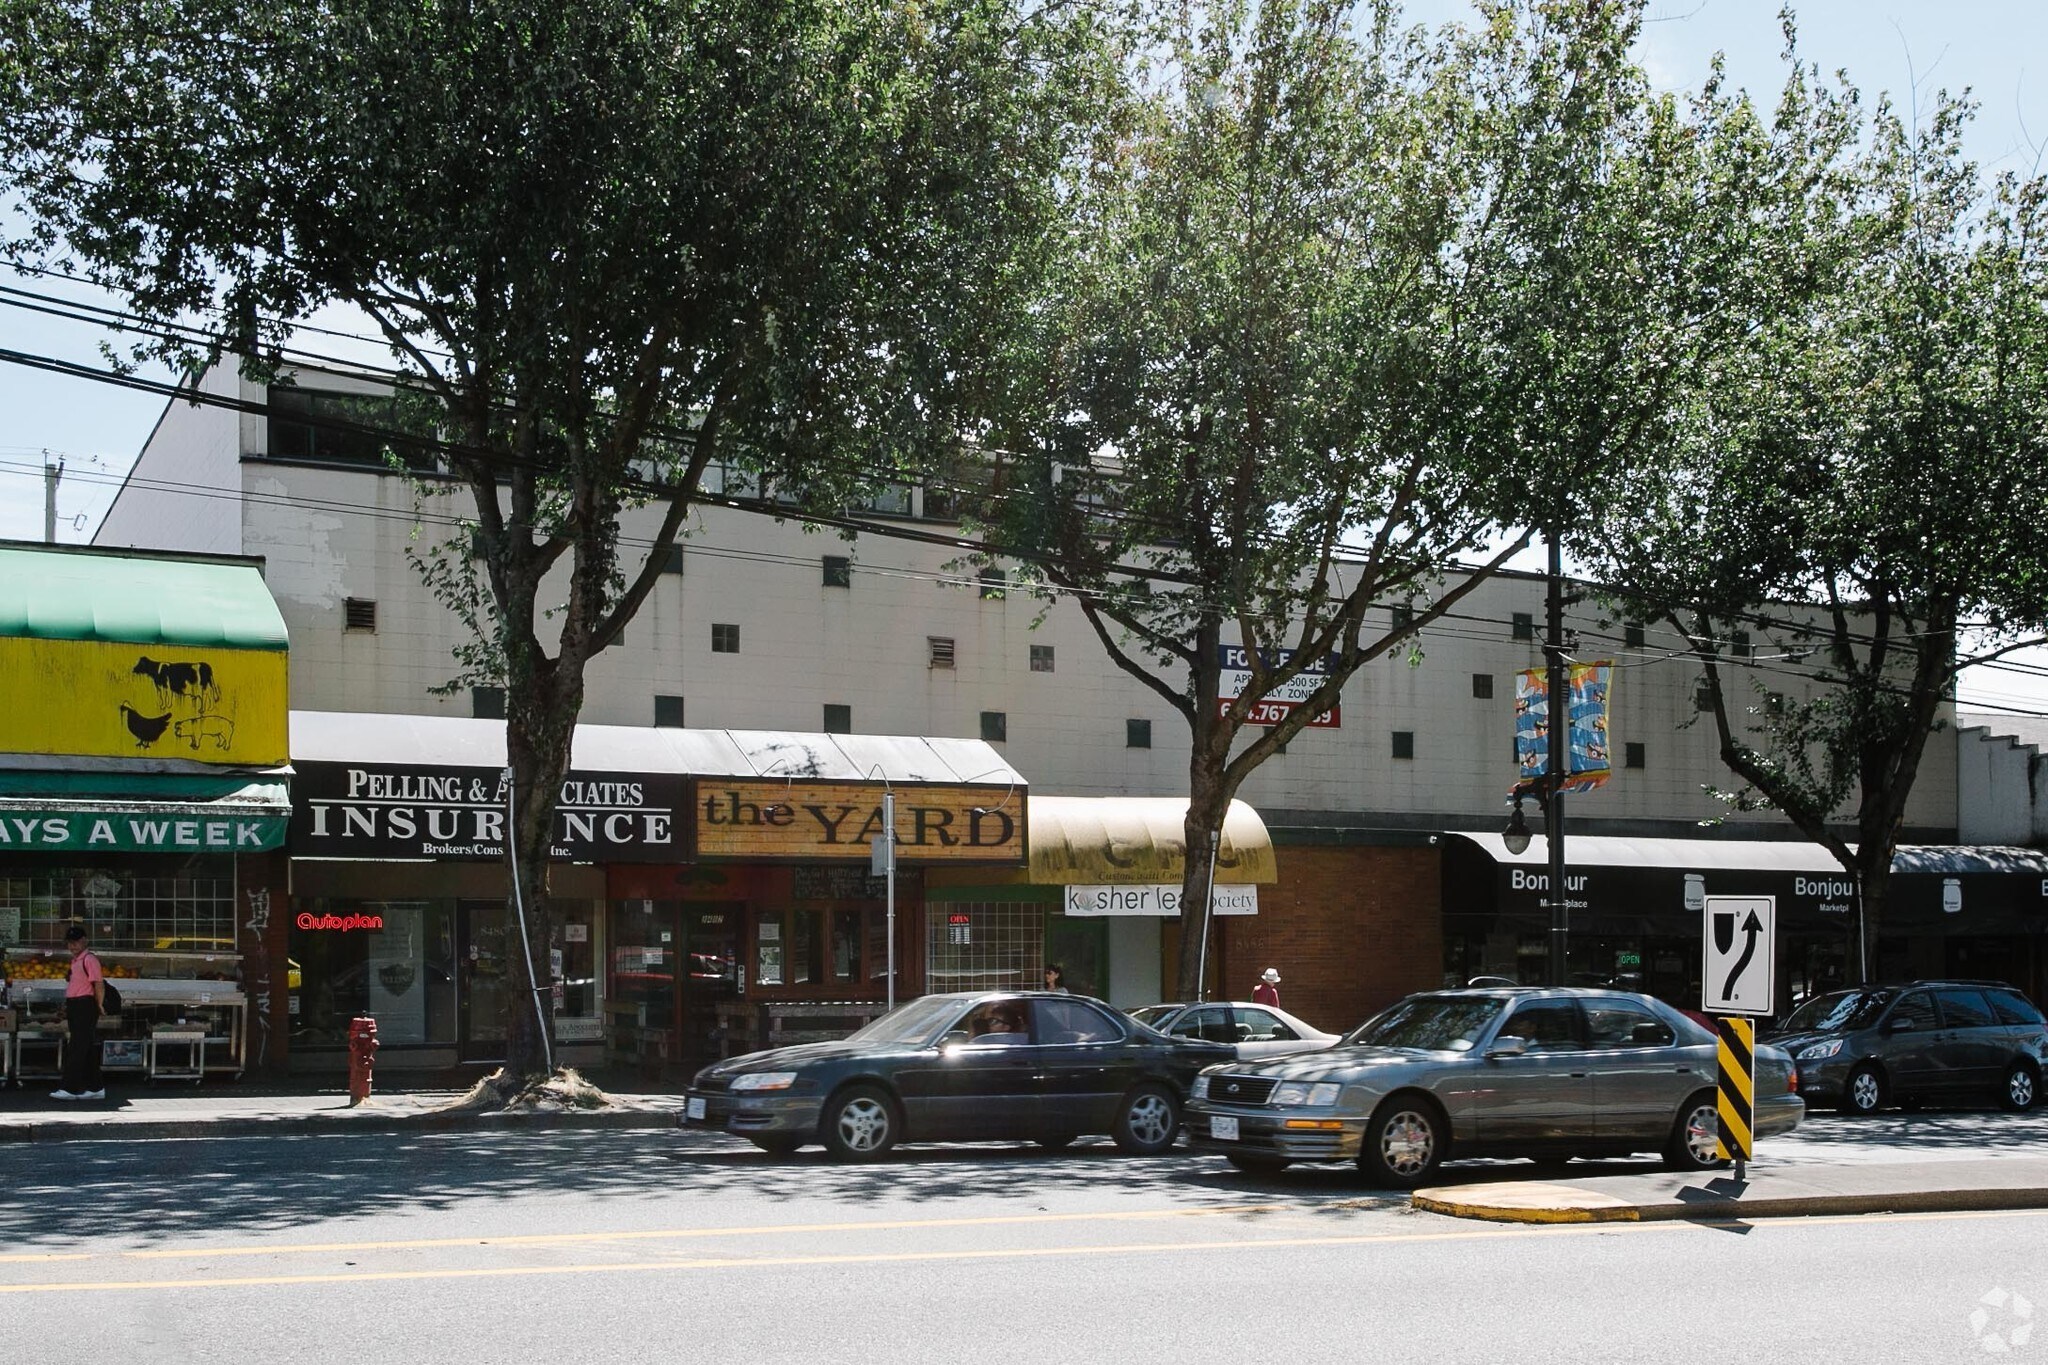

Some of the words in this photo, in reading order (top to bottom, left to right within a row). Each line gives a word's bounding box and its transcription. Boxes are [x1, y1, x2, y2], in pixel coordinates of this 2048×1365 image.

[347, 769, 463, 802] PELLING
[468, 777, 488, 803] &
[493, 781, 644, 807] ACIATES
[310, 804, 673, 845] INSURNCE
[702, 790, 796, 826] the
[802, 804, 1015, 848] YARD
[88, 819, 117, 845] A
[129, 820, 264, 847] WEEK
[1511, 869, 1588, 891] Bonur
[1795, 876, 1853, 901] Bonjou
[1156, 886, 1185, 911] lea
[1212, 889, 1255, 911] ociety
[1819, 903, 1850, 914] Marketpl
[297, 912, 383, 933] Autoplan
[1621, 954, 1641, 965] OPEN
